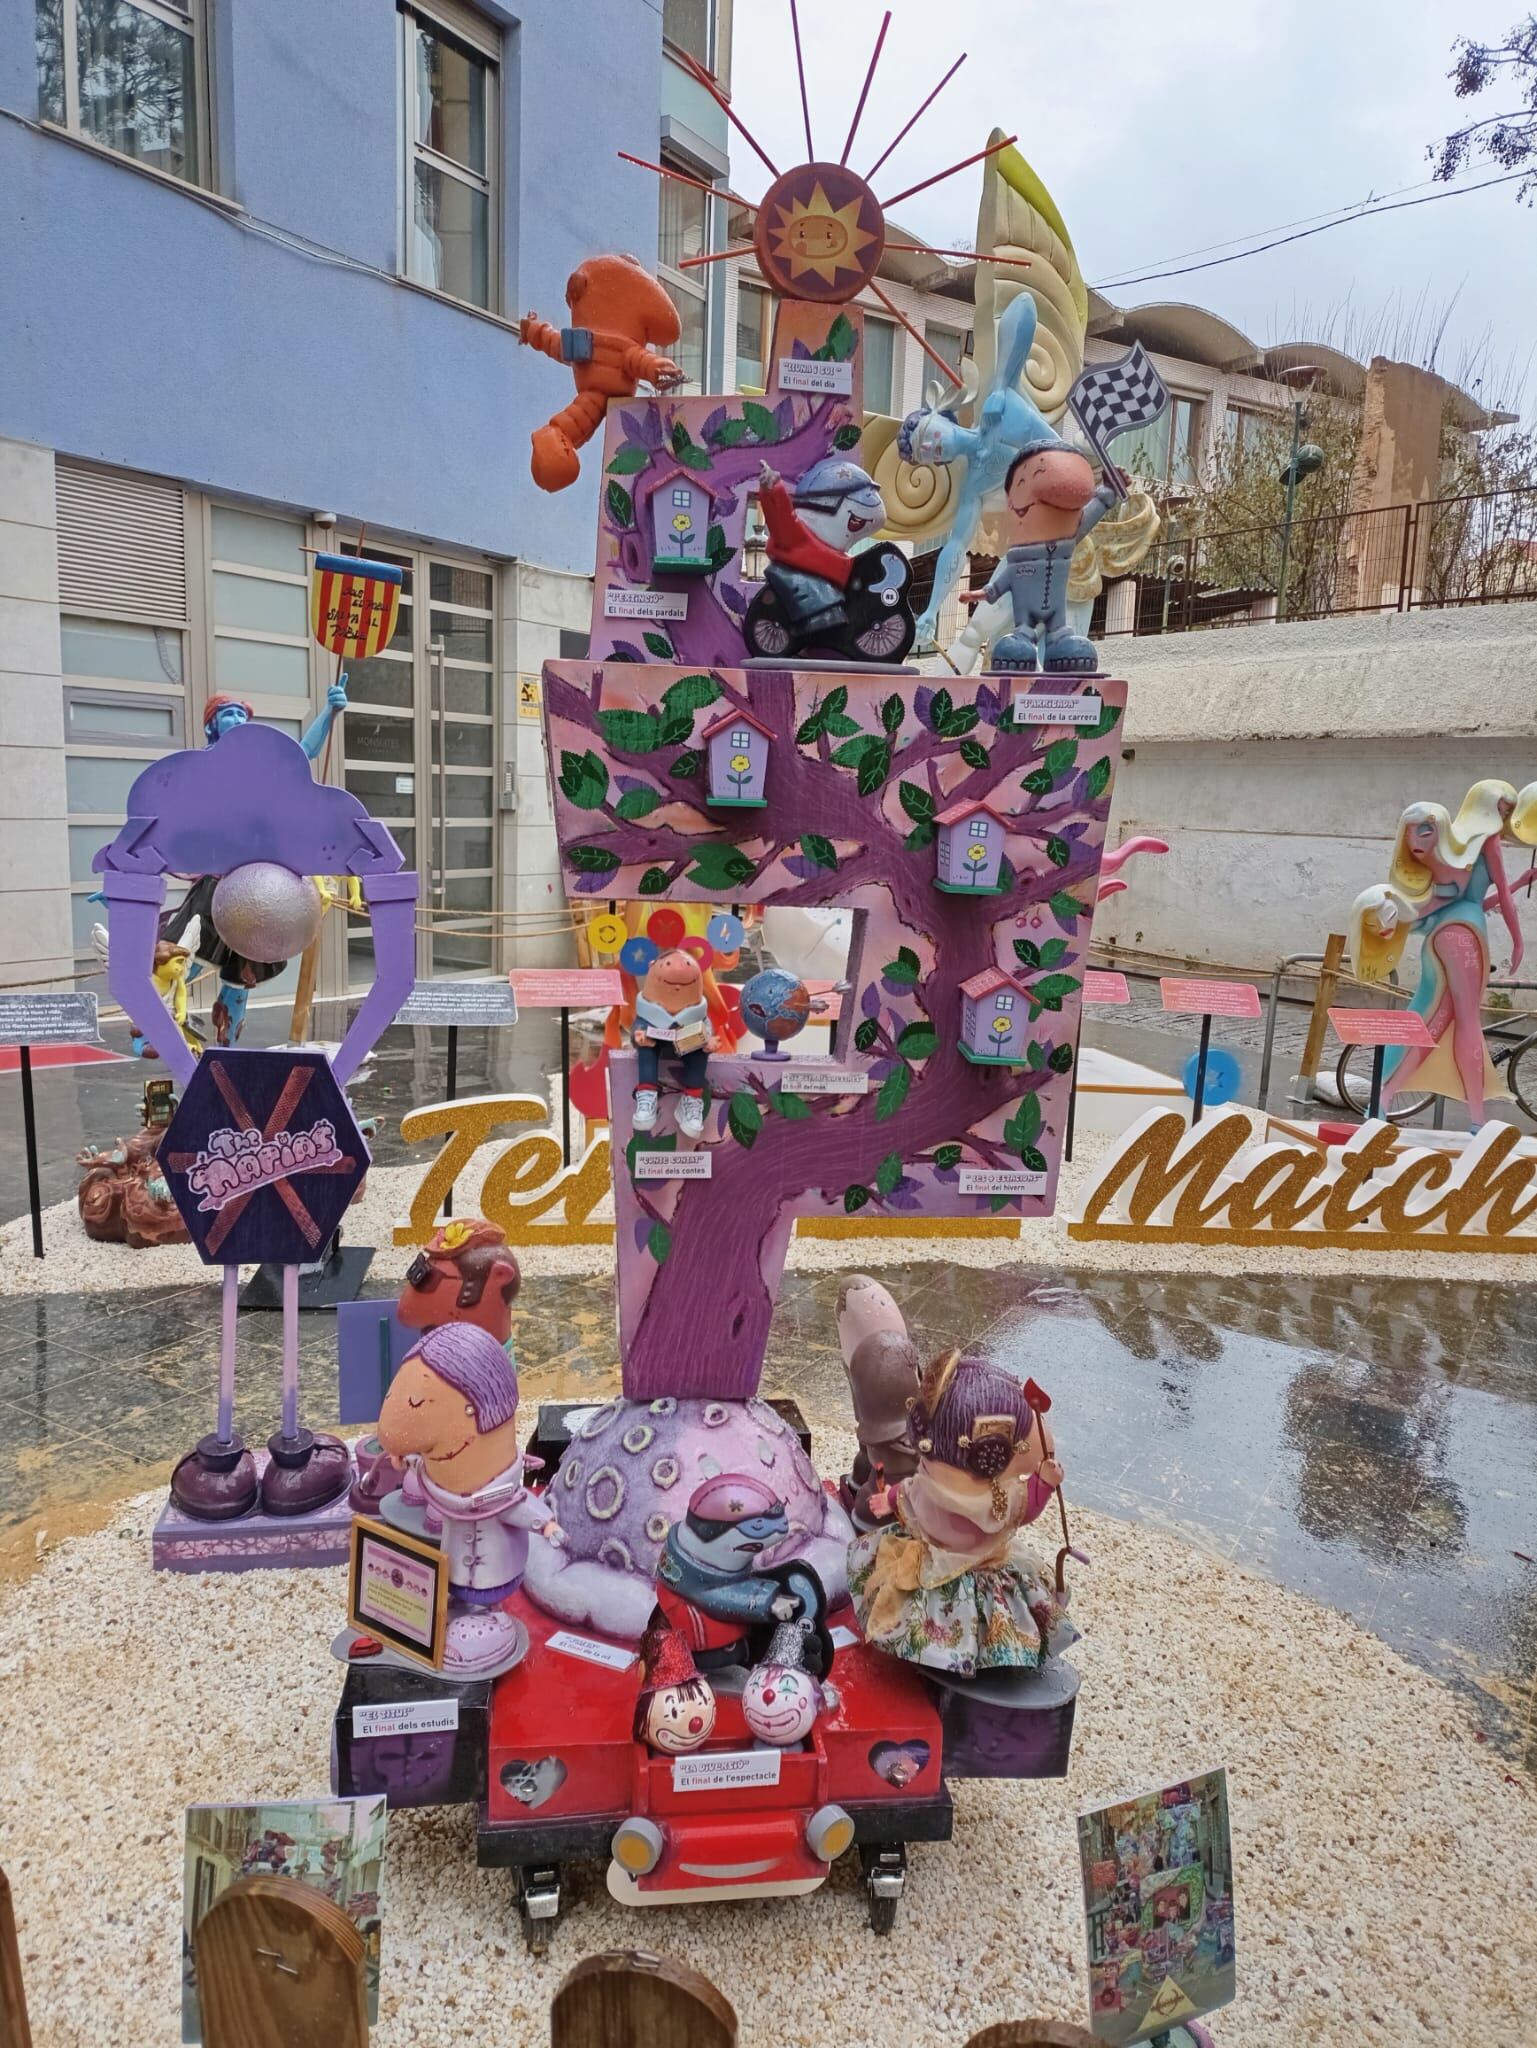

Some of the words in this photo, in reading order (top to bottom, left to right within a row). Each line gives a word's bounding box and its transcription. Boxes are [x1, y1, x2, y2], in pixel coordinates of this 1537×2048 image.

[784, 376, 791, 384] El
[793, 376, 809, 386] final
[811, 378, 822, 387] del
[608, 606, 616, 614] El
[619, 607, 635, 615] final
[637, 608, 653, 616] dels
[655, 609, 685, 617] pardals
[1018, 712, 1026, 720] El
[681, 1167, 706, 1175] contes
[1084, 1112, 1537, 1237] Match
[362, 1725, 372, 1734] El
[375, 1724, 396, 1733] final
[398, 1722, 418, 1731] dels
[420, 1718, 455, 1728] estudis
[681, 1777, 690, 1786] El
[692, 1776, 711, 1785] final
[713, 1775, 725, 1783] de
[726, 1771, 777, 1783] l'espectacle
